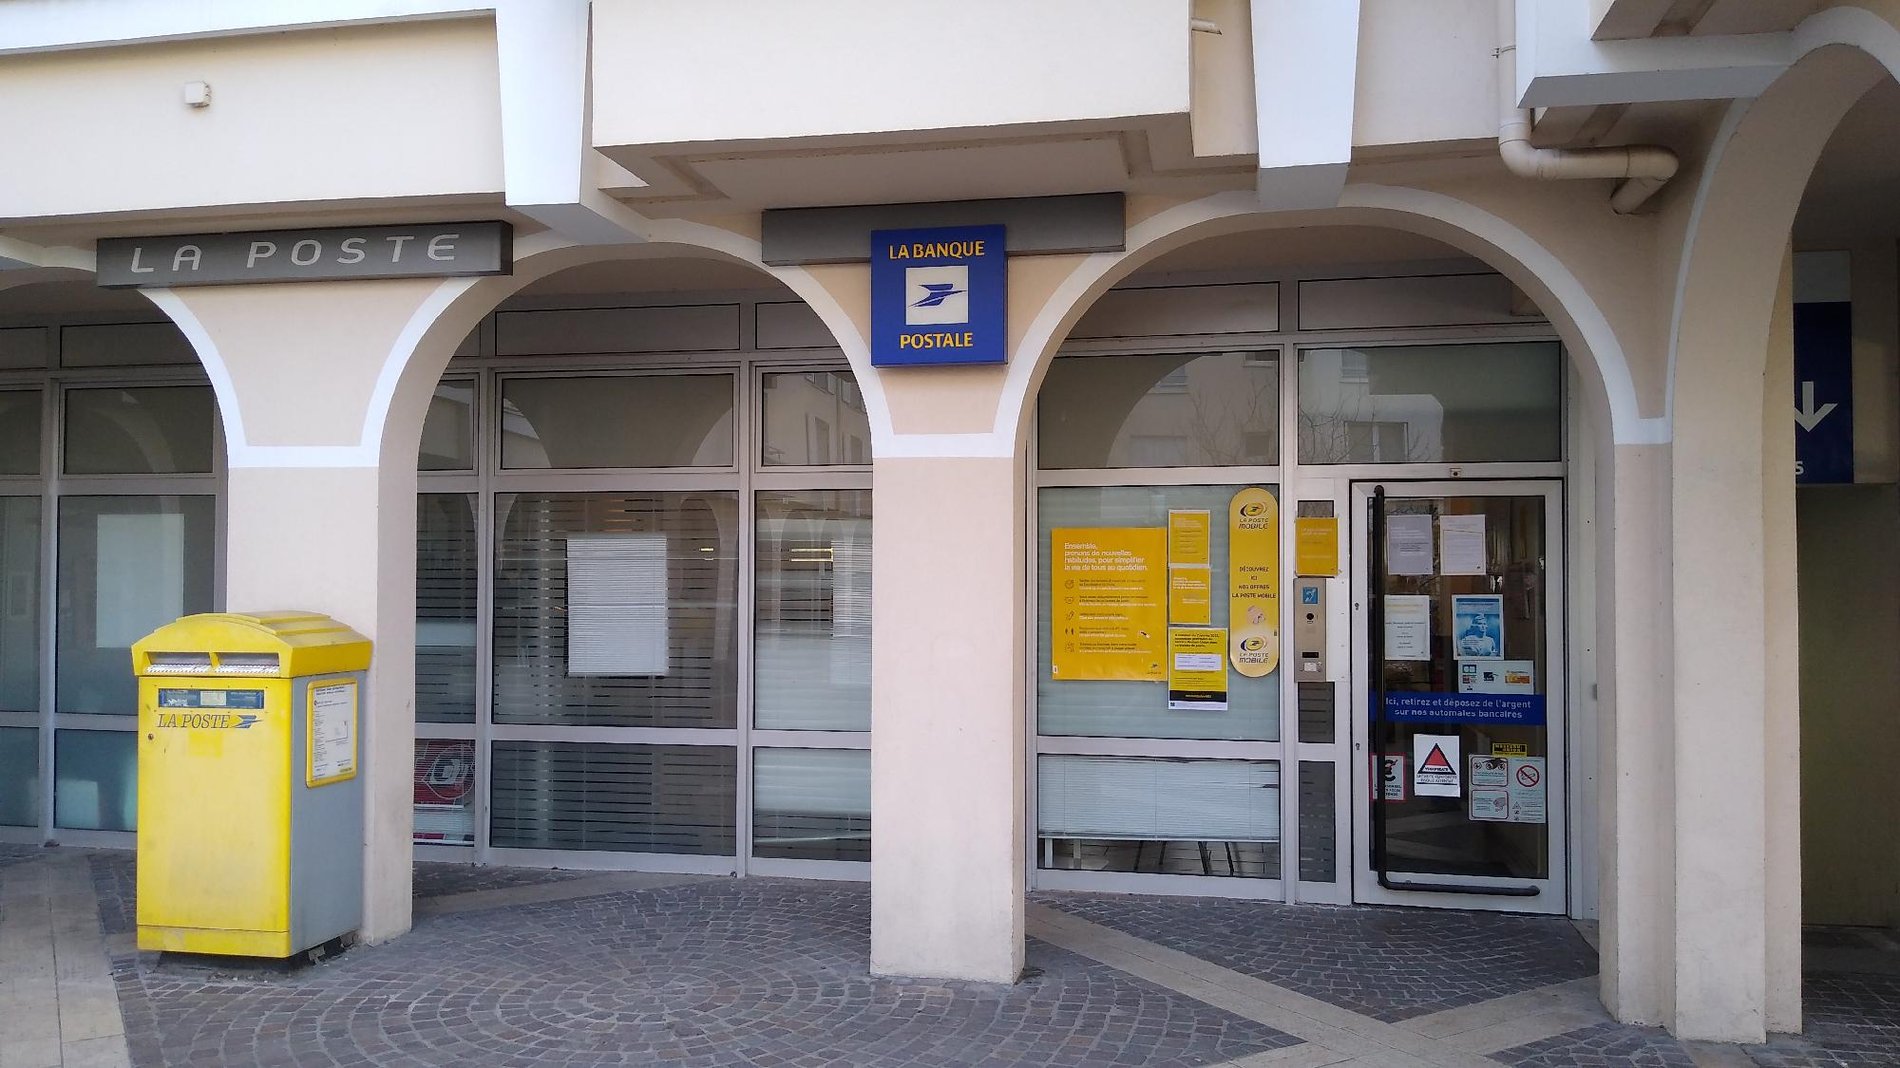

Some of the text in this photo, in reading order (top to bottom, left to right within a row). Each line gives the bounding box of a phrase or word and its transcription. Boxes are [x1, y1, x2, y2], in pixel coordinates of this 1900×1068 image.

[131, 233, 460, 273] LA POSTE
[889, 240, 985, 259] LA BANQUE
[900, 332, 973, 349] POSTALE
[1386, 697, 1399, 706] Ici,
[1401, 697, 1430, 706] retirez
[1444, 698, 1480, 708] déposez
[1483, 699, 1493, 707] de
[1495, 700, 1531, 710] l'argent
[157, 713, 230, 728] LA POSTE
[1479, 710, 1522, 718] bancaires
